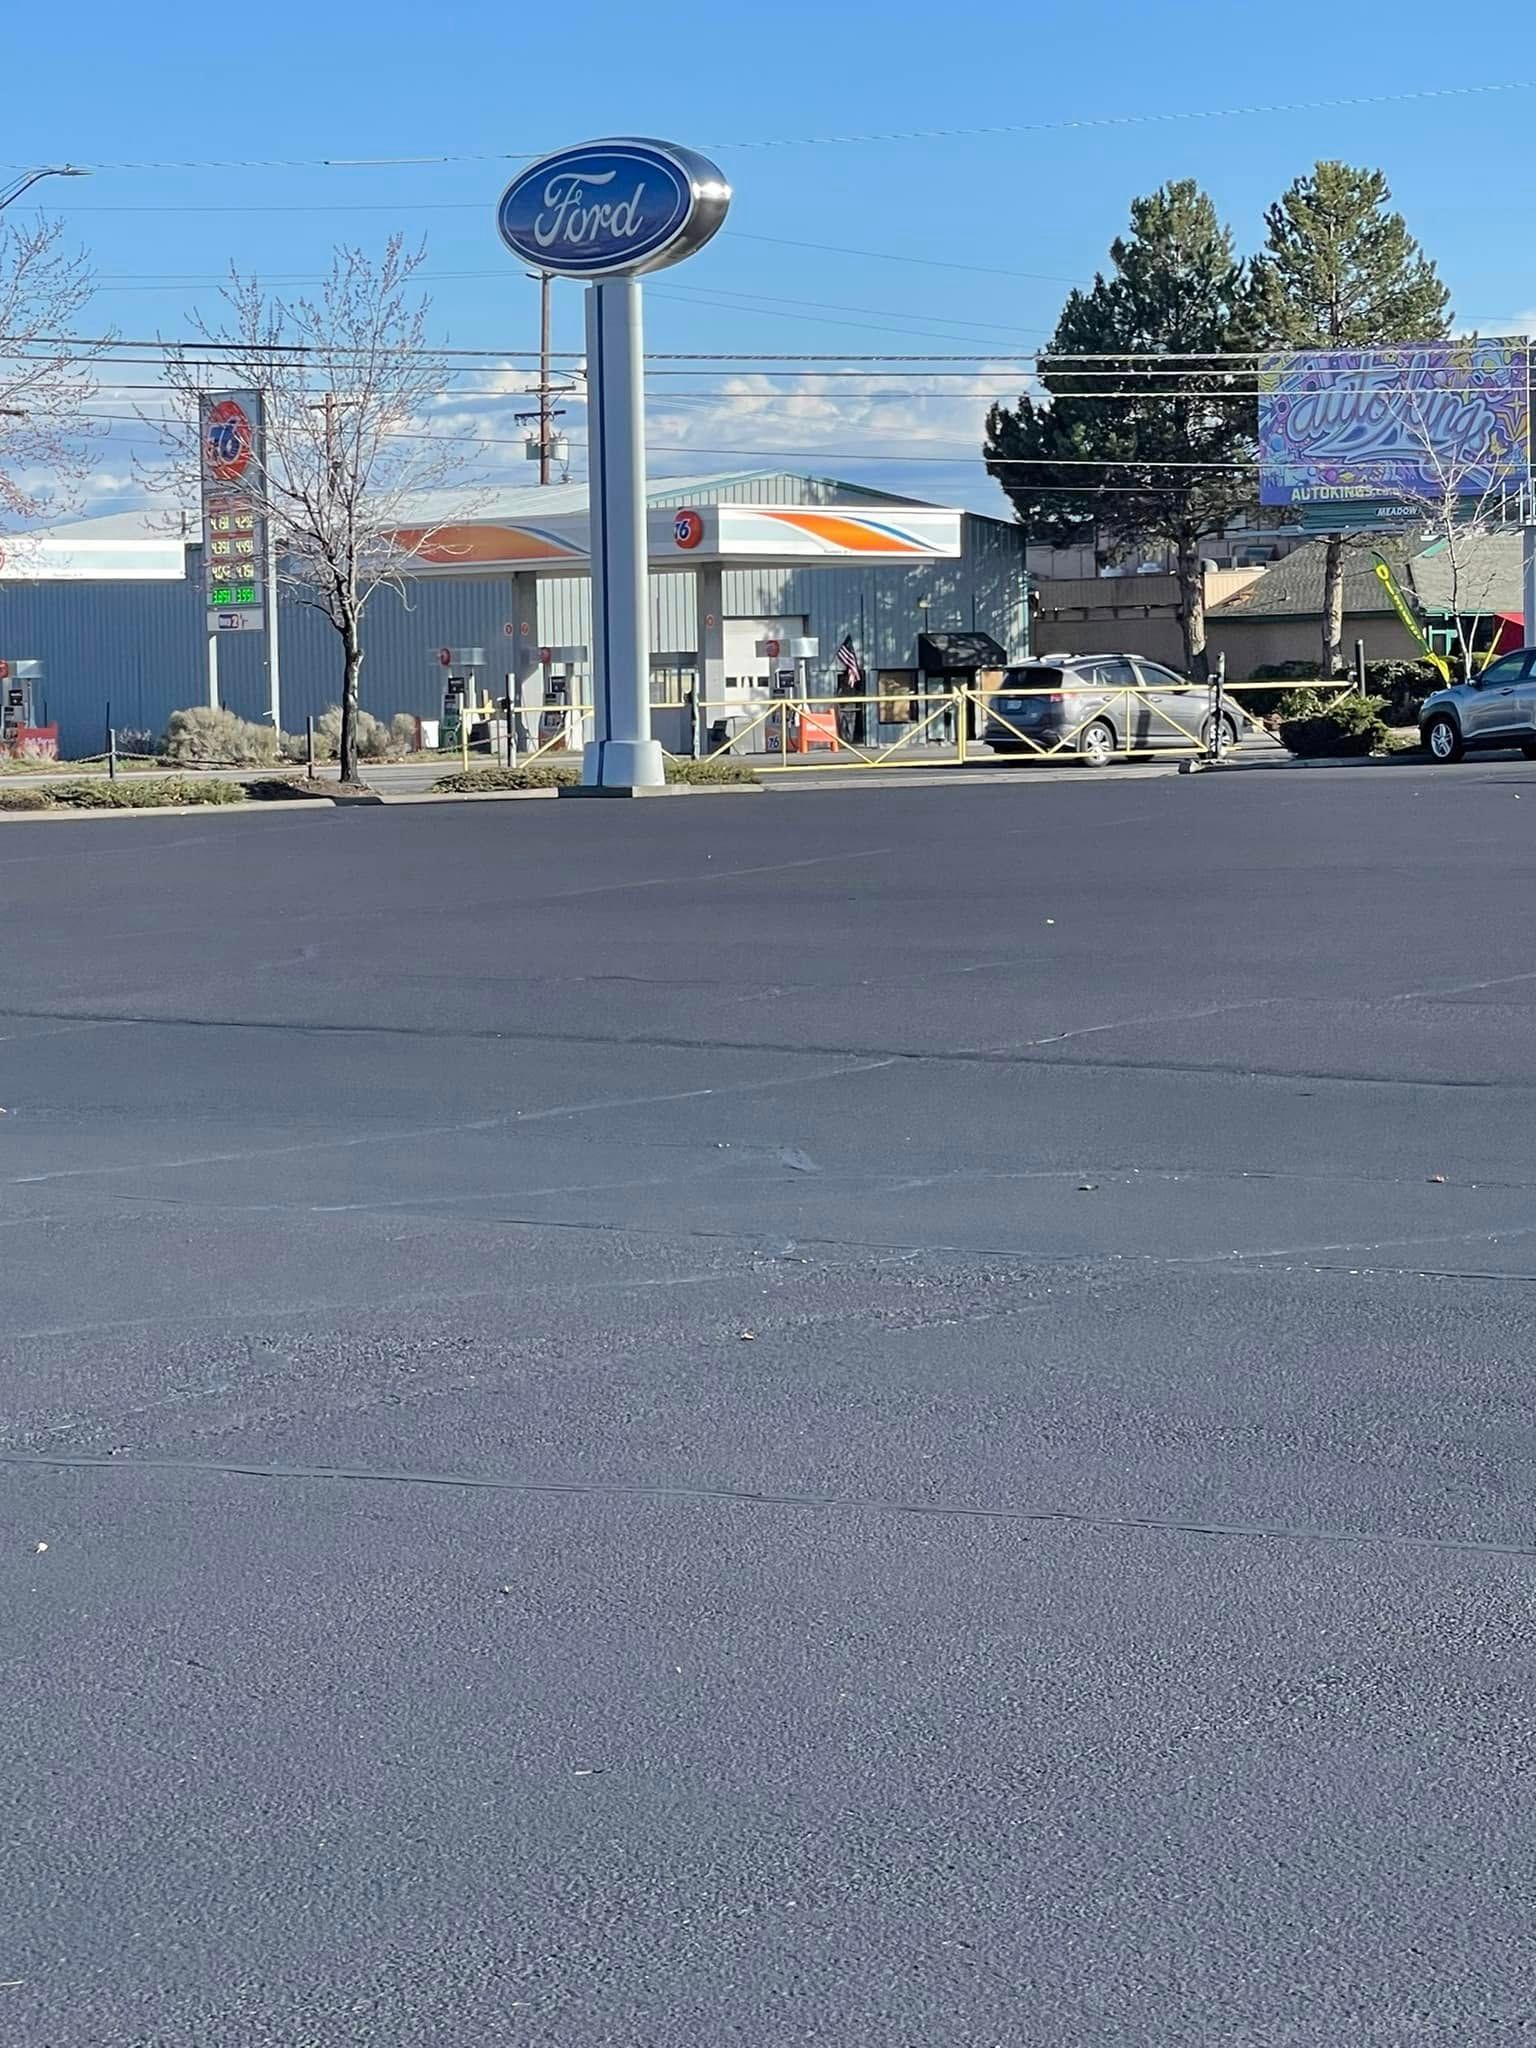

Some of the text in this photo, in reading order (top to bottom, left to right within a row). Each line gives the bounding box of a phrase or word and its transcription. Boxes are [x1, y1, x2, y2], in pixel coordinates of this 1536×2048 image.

[534, 170, 646, 247] Ford
[208, 415, 241, 464] 76
[1377, 507, 1417, 516] MEADOW
[674, 519, 691, 541] 76
[767, 735, 779, 748] 76
